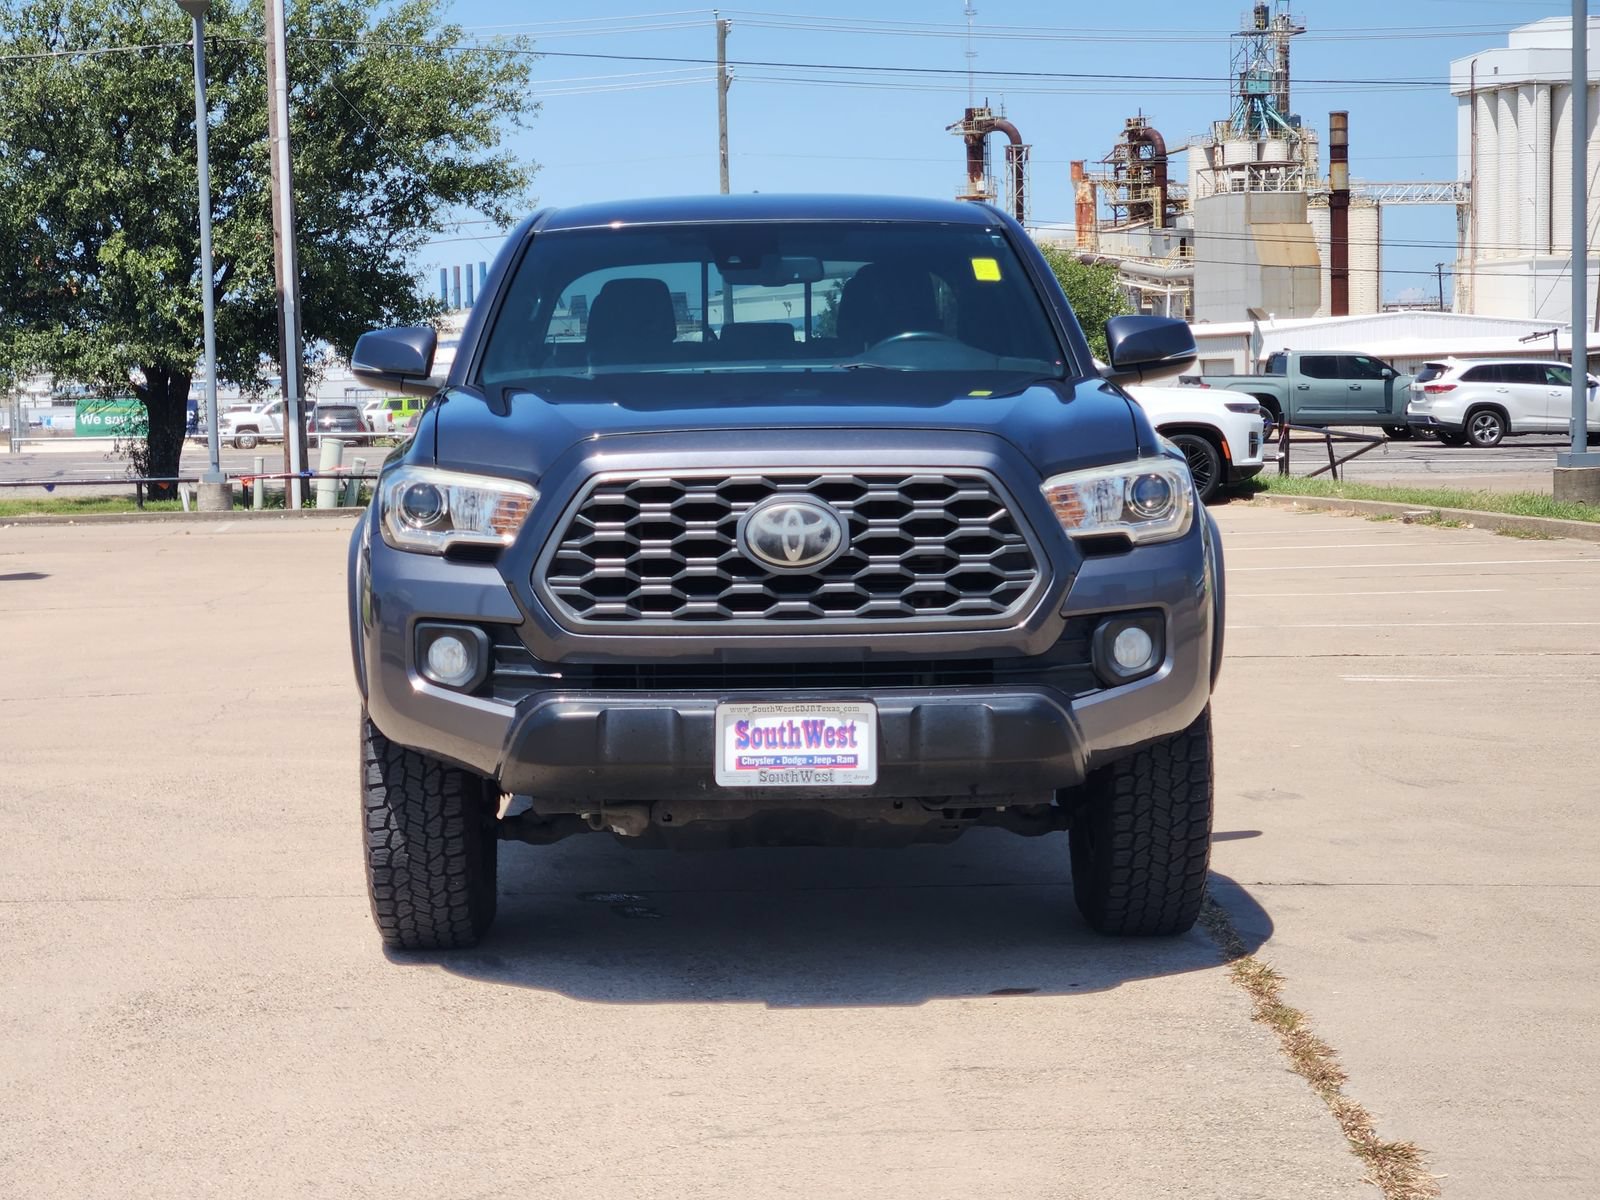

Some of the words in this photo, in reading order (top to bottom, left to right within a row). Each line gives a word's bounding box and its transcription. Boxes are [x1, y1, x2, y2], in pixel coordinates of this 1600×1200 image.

[80, 414, 101, 425] We
[735, 719, 858, 750] SouthWest
[741, 757, 775, 766] Chrysler
[781, 756, 807, 765] Dodge
[813, 755, 832, 765] Jeep
[836, 755, 855, 764] Ram
[759, 770, 834, 783] SouthWest
